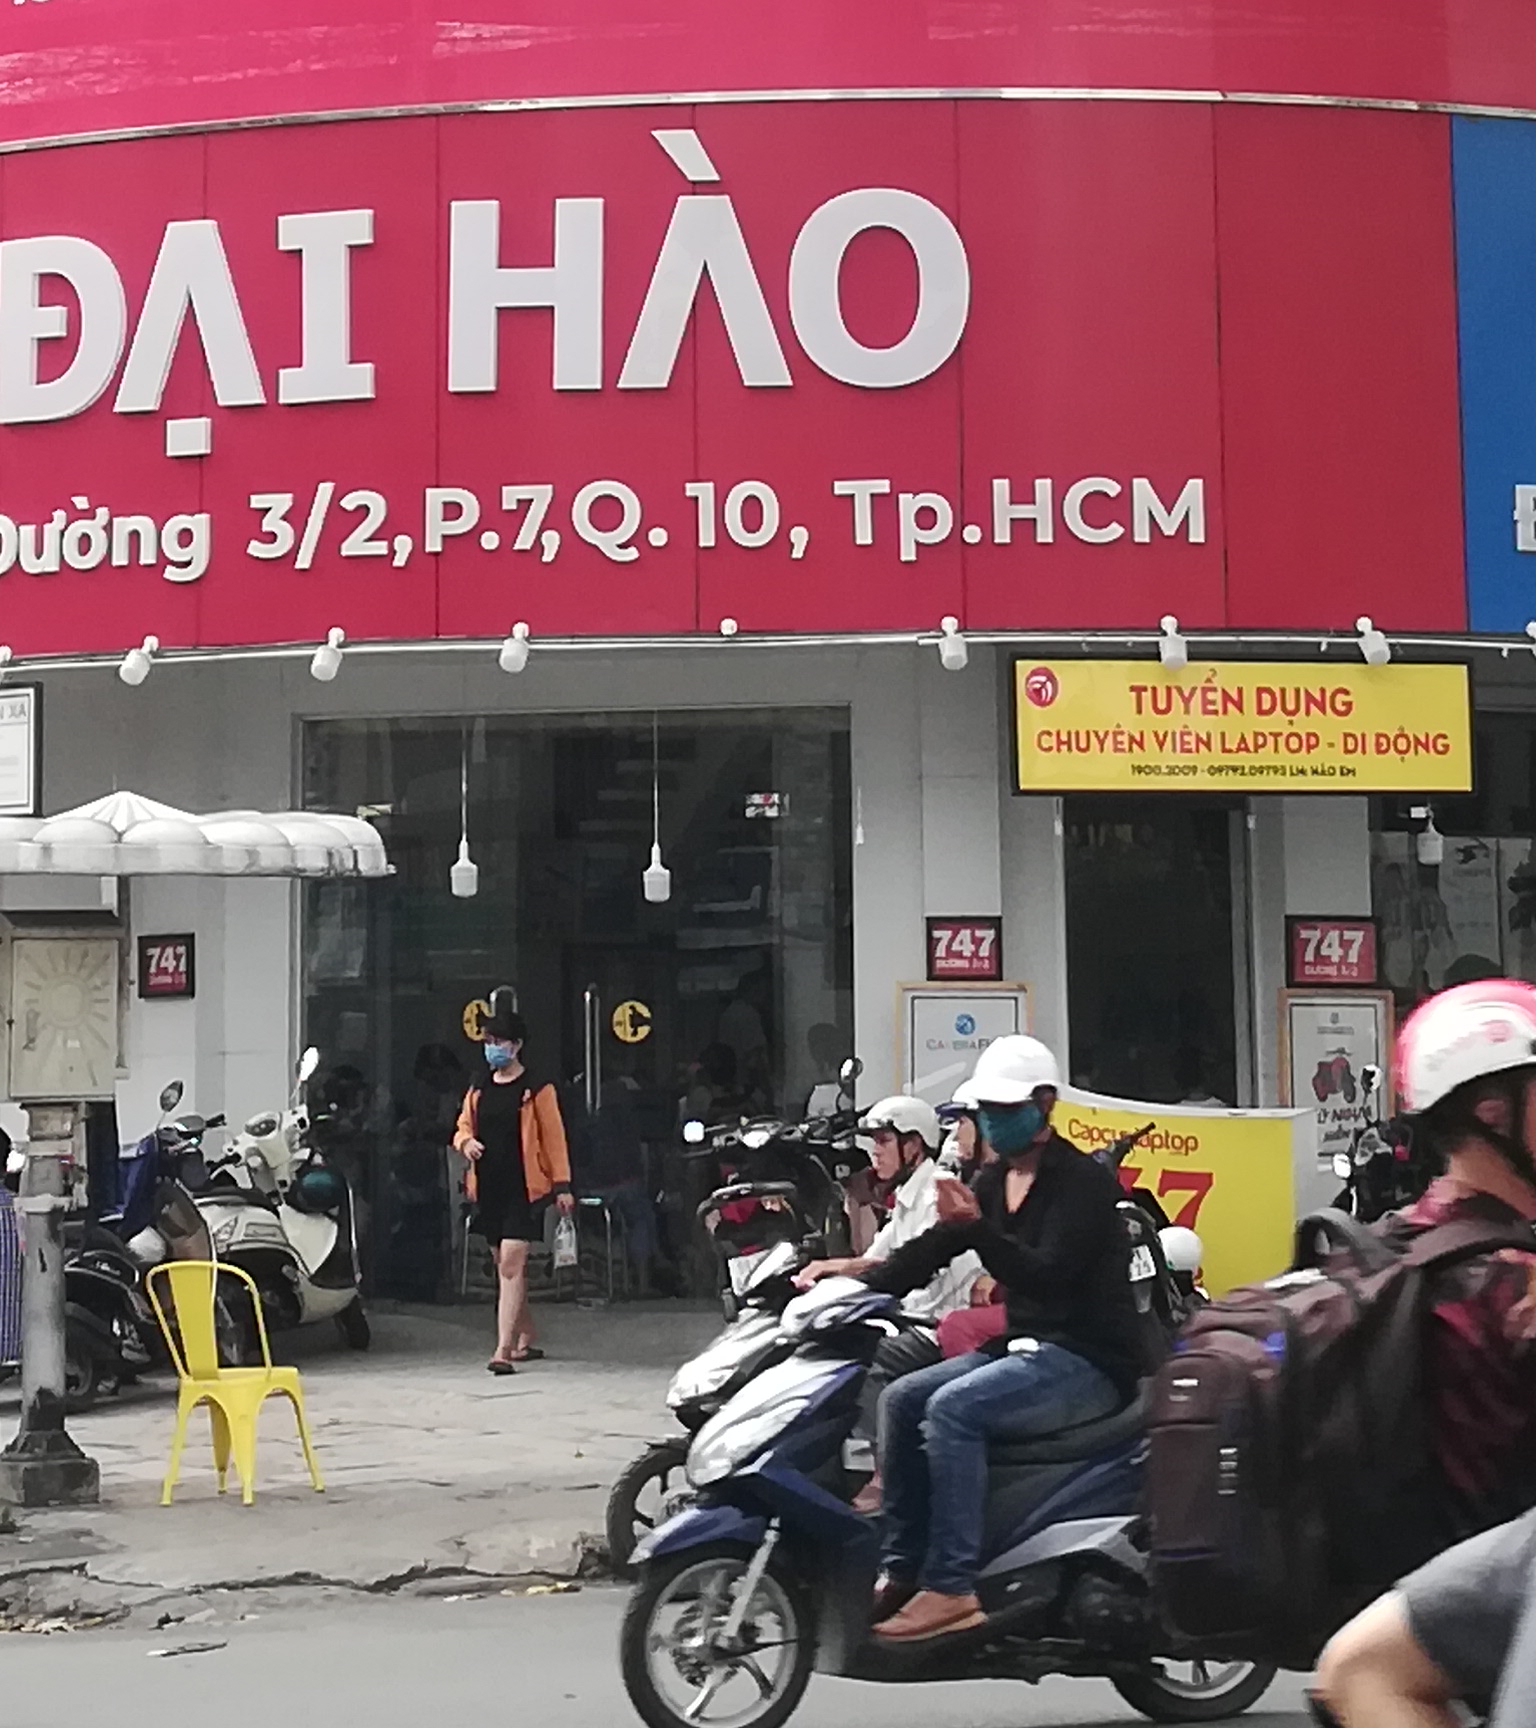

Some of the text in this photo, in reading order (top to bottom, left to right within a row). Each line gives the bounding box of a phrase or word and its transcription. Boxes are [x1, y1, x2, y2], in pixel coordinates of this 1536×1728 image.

[447, 128, 971, 393] HÀO
[833, 475, 1207, 563] Tp.HCM
[1128, 669, 1355, 726] TUYỂN DỤNG
[1036, 722, 1146, 755] CHUYÊN
[1153, 723, 1212, 755] VIÊN
[1220, 730, 1321, 755] LAPTOP
[1342, 732, 1368, 756] DI
[1374, 725, 1451, 763] ĐỘNG
[145, 944, 187, 974] 747
[931, 928, 996, 958] 747
[1299, 928, 1365, 963] 747
